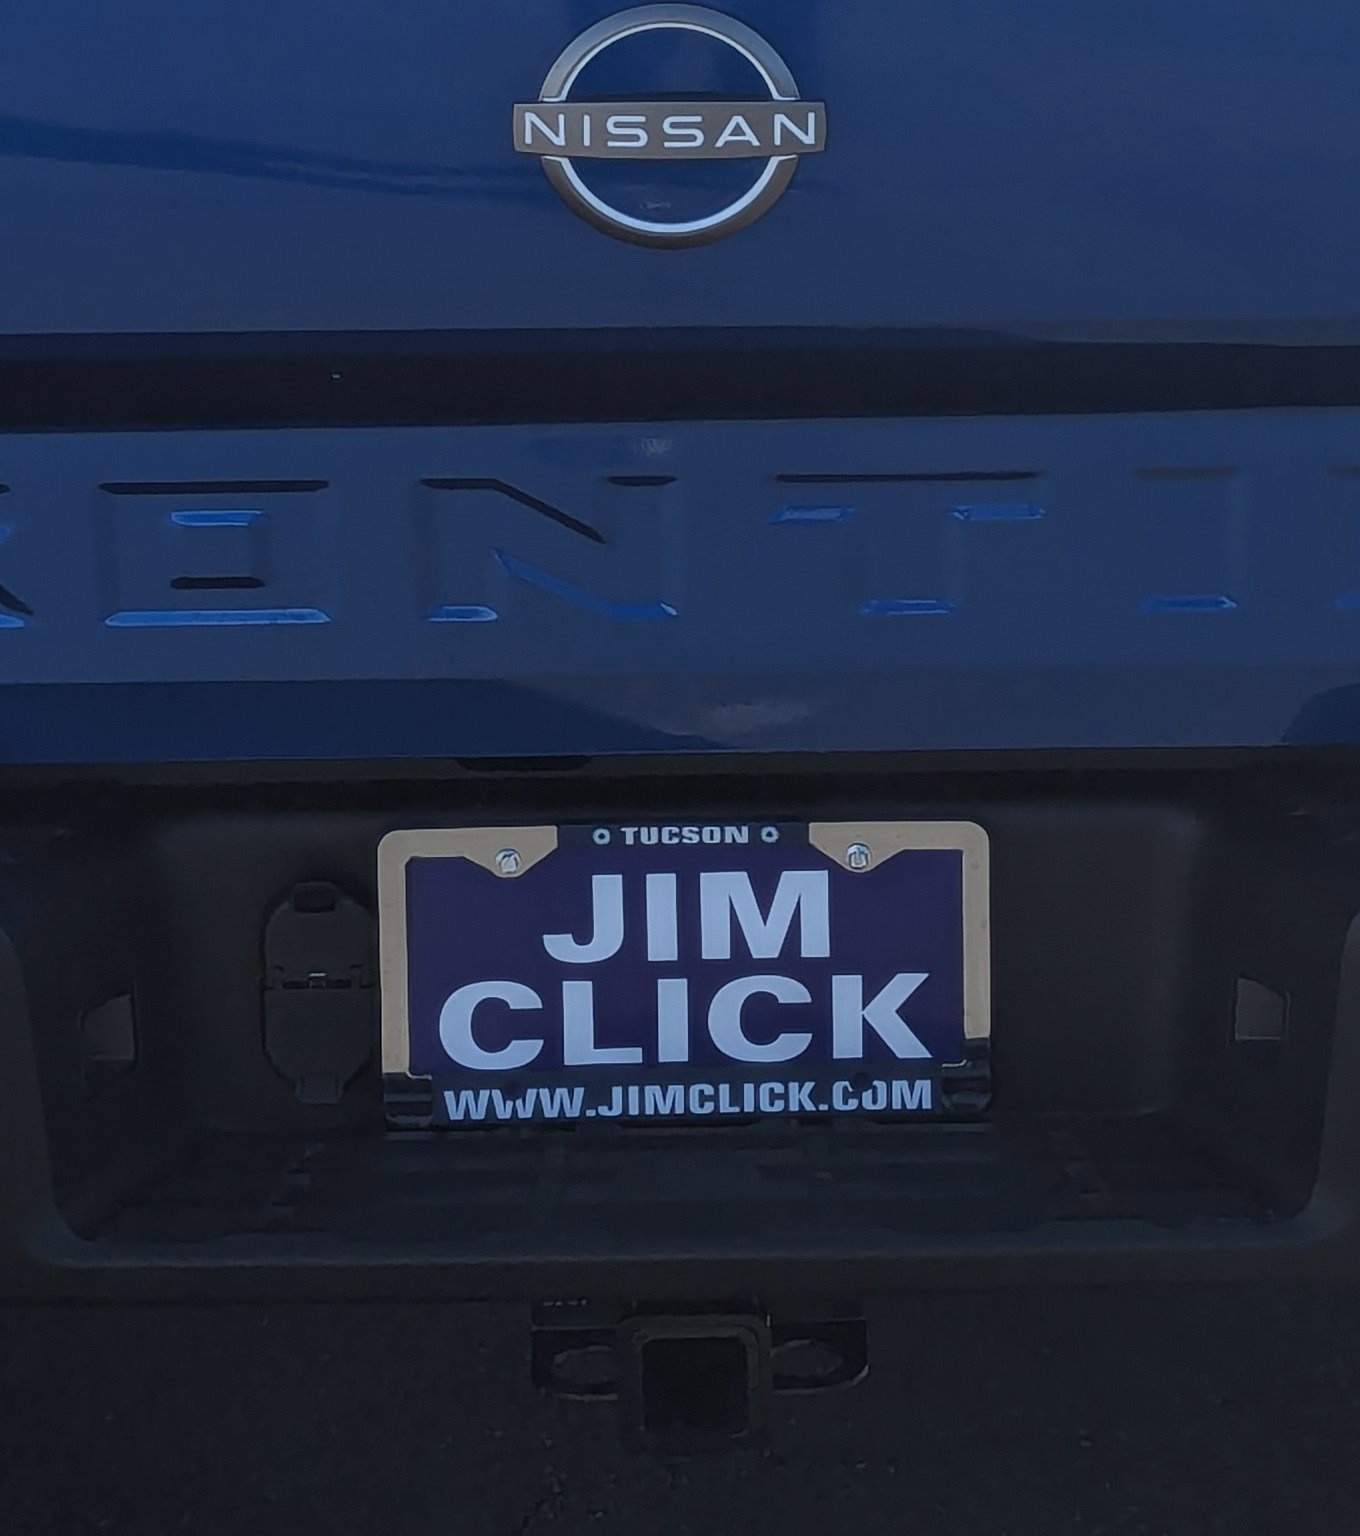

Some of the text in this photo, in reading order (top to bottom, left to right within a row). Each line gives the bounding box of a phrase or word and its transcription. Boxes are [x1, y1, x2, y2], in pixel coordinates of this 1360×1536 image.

[524, 111, 816, 148] NISSAN
[621, 825, 749, 845] TUCSON
[542, 869, 830, 963] JIM
[439, 972, 933, 1070] CLICK
[443, 1078, 933, 1120] WWW.JIMCLICK.COM
